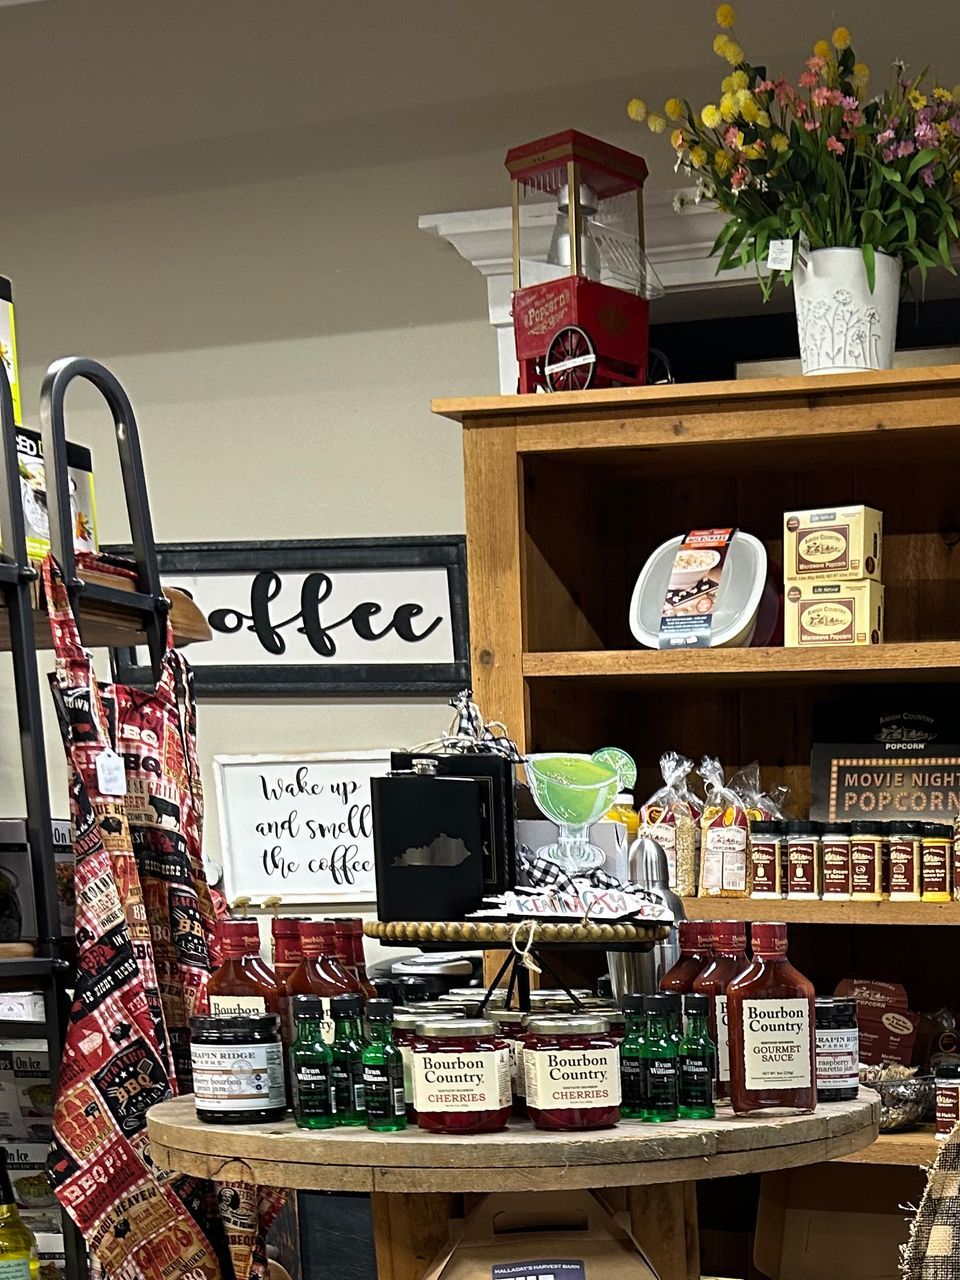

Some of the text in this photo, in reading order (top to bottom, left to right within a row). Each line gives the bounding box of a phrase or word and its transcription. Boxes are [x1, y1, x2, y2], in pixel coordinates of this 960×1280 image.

[208, 571, 443, 657] offee
[260, 767, 362, 804] Wake up
[844, 772, 903, 787] MOVIE
[256, 804, 374, 838] and smell
[263, 845, 374, 885] the coffee
[213, 1002, 260, 1016] Bourbon
[747, 1006, 804, 1020] Bourbon
[749, 1020, 804, 1035] Country
[753, 1045, 801, 1054] GOURMET
[16, 1055, 41, 1070] On Ice
[423, 1056, 484, 1070] Bourbon
[547, 1055, 608, 1067] Bourbon
[762, 1054, 794, 1062] SAUCE
[818, 1058, 849, 1068] raspberry
[297, 1073, 327, 1081] Williams
[364, 1067, 381, 1075] Evan
[550, 1068, 608, 1085] Country
[650, 1067, 676, 1075] Williams
[424, 1071, 485, 1086] Country
[428, 1093, 486, 1103] CHERRIES
[552, 1090, 609, 1100] CHERRIES
[16, 1150, 29, 1162] Ice
[115, 1187, 157, 1217] HEAVEN
[179, 1249, 207, 1273] SMOKED
[494, 1264, 532, 1274] HALLADAY'S
[532, 1263, 562, 1271] HARVEST
